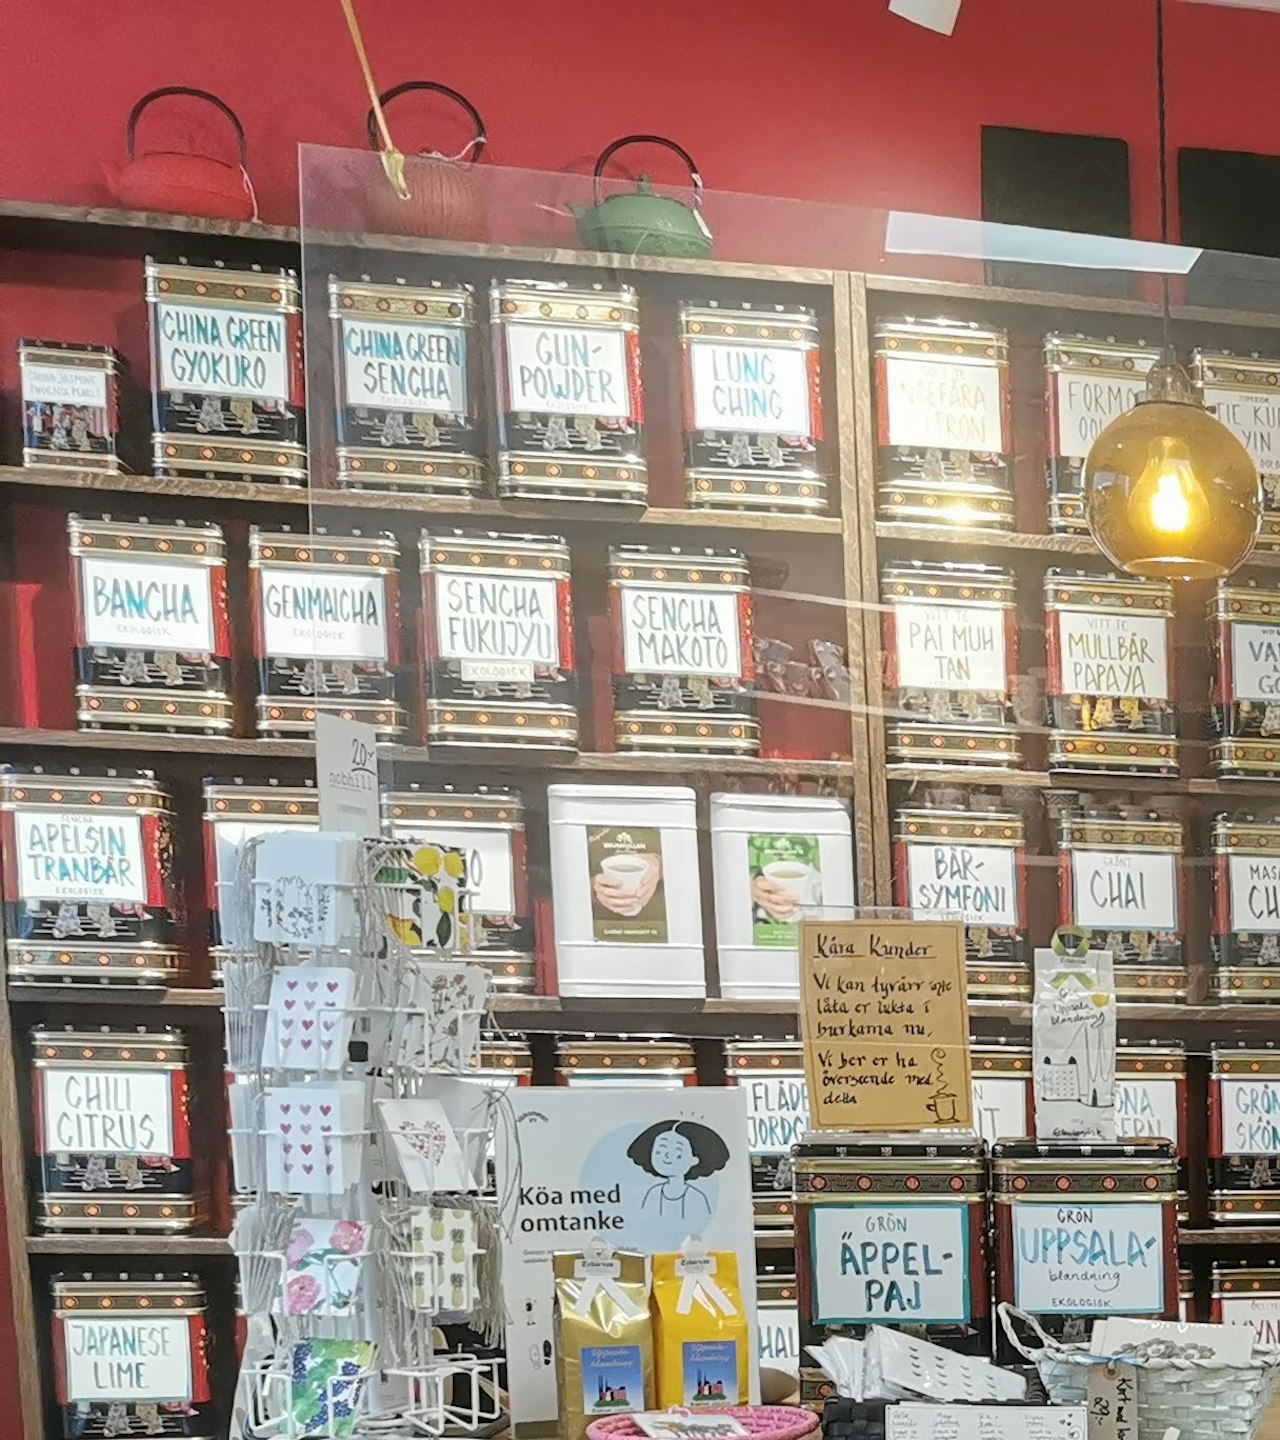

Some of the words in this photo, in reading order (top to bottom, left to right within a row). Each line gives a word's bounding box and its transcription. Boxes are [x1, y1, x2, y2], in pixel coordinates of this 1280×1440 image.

[162, 311, 220, 343] CHINA
[226, 317, 281, 352] GREEN
[347, 328, 402, 359] CHINA
[406, 330, 460, 366] GREEN
[171, 352, 265, 388] GYOKURO
[363, 363, 450, 398] SENCHA
[521, 364, 614, 404] POWDER
[713, 351, 776, 385] LUNG
[713, 385, 783, 419] CHING
[1241, 430, 1272, 452] YIN
[92, 577, 198, 624] BANCHA
[264, 582, 379, 628] GENMAICHA
[448, 580, 544, 619] SENCHA
[449, 616, 553, 659] FUKUJYU
[638, 631, 729, 669] MAKOTO
[909, 624, 951, 654] PAI
[957, 624, 994, 652] MUH
[1068, 631, 1154, 669] MULLBÄR
[936, 654, 971, 681] TAN
[1071, 661, 1147, 696] PAPAYA
[328, 773, 374, 791] nobhill
[28, 825, 126, 858] APELSIN
[27, 853, 135, 887] TRANBÄR
[918, 884, 1006, 914] SYMFONI
[1089, 868, 1146, 910] CHAI
[869, 933, 935, 957] Kunder
[64, 1076, 131, 1109] CHILI
[57, 1112, 155, 1150] CITRUS
[520, 1185, 562, 1206] Köa
[570, 1184, 620, 1204] med
[520, 1211, 624, 1232] omtanke
[1057, 1208, 1093, 1225] GRÖN
[865, 1280, 922, 1312] PAJ
[1048, 1269, 1122, 1292] blandning
[1051, 1297, 1113, 1309] EKOLOGISK
[71, 1324, 171, 1357] JAPANESE
[93, 1361, 150, 1390] LIME
